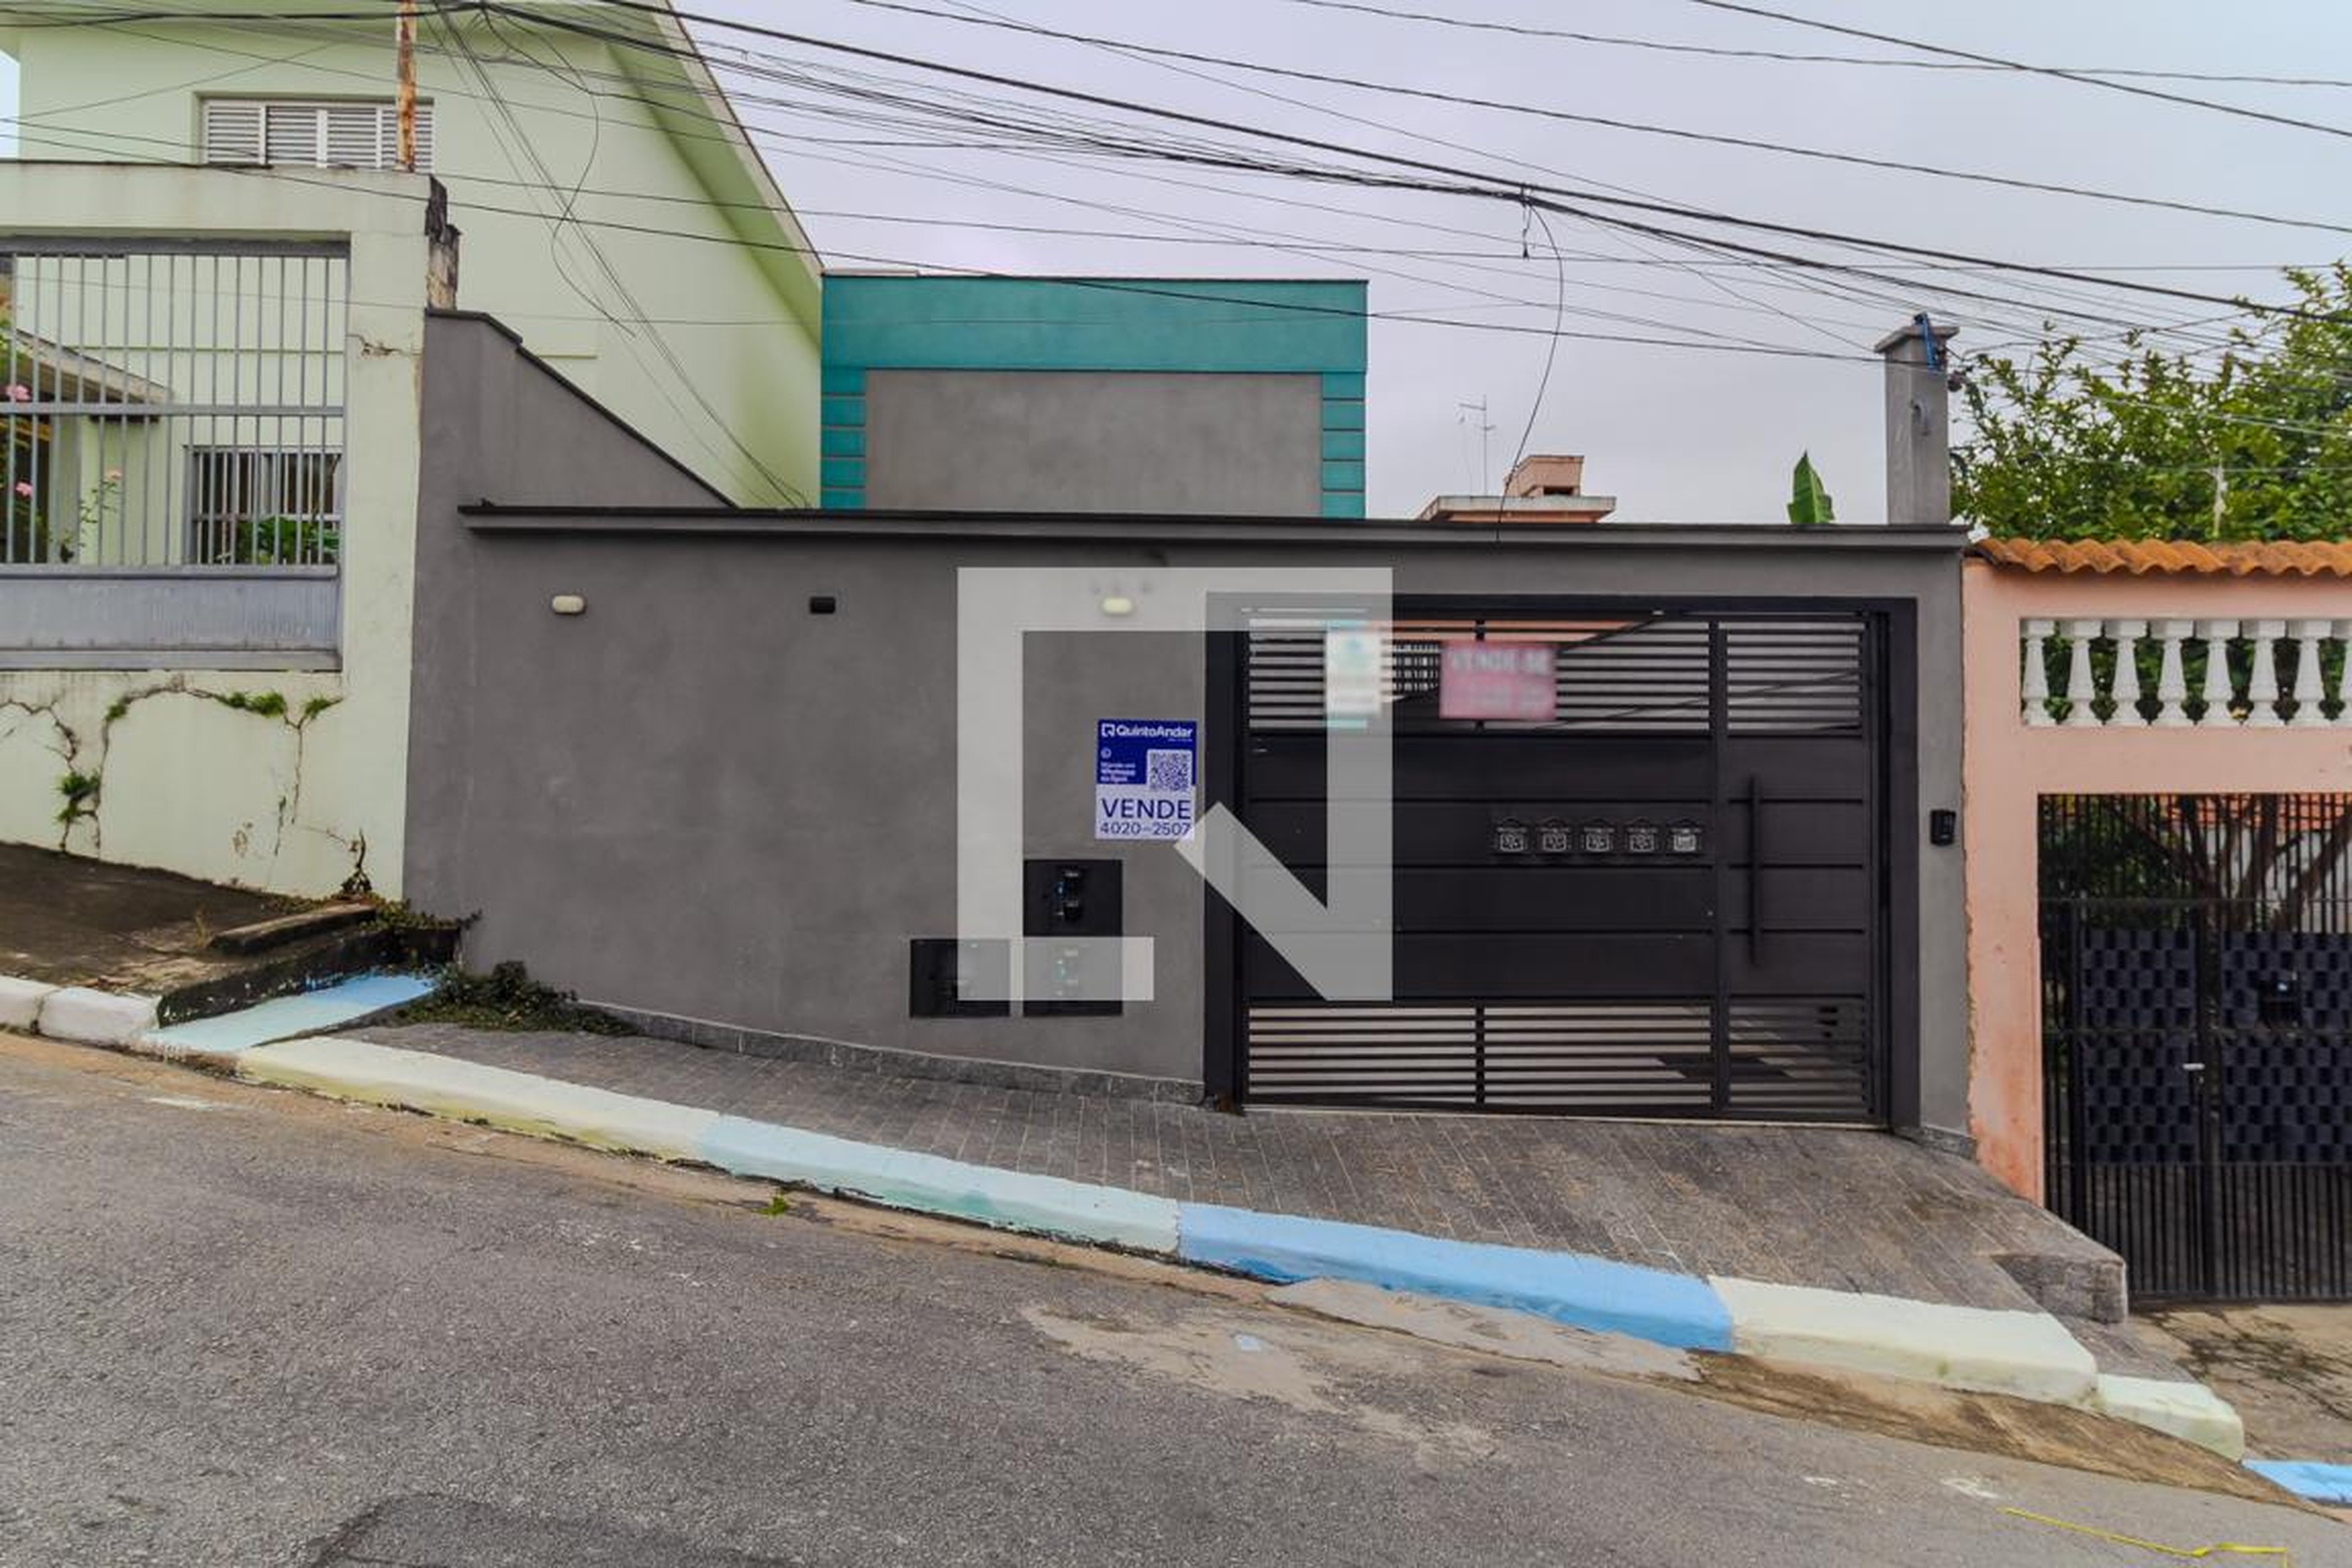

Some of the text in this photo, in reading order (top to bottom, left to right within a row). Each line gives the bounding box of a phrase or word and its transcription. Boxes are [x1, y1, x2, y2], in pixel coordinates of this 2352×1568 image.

[1116, 724, 1193, 737] QuintoAndar
[1101, 798, 1191, 819] VENDE
[1101, 821, 1191, 835] 4020-2507
